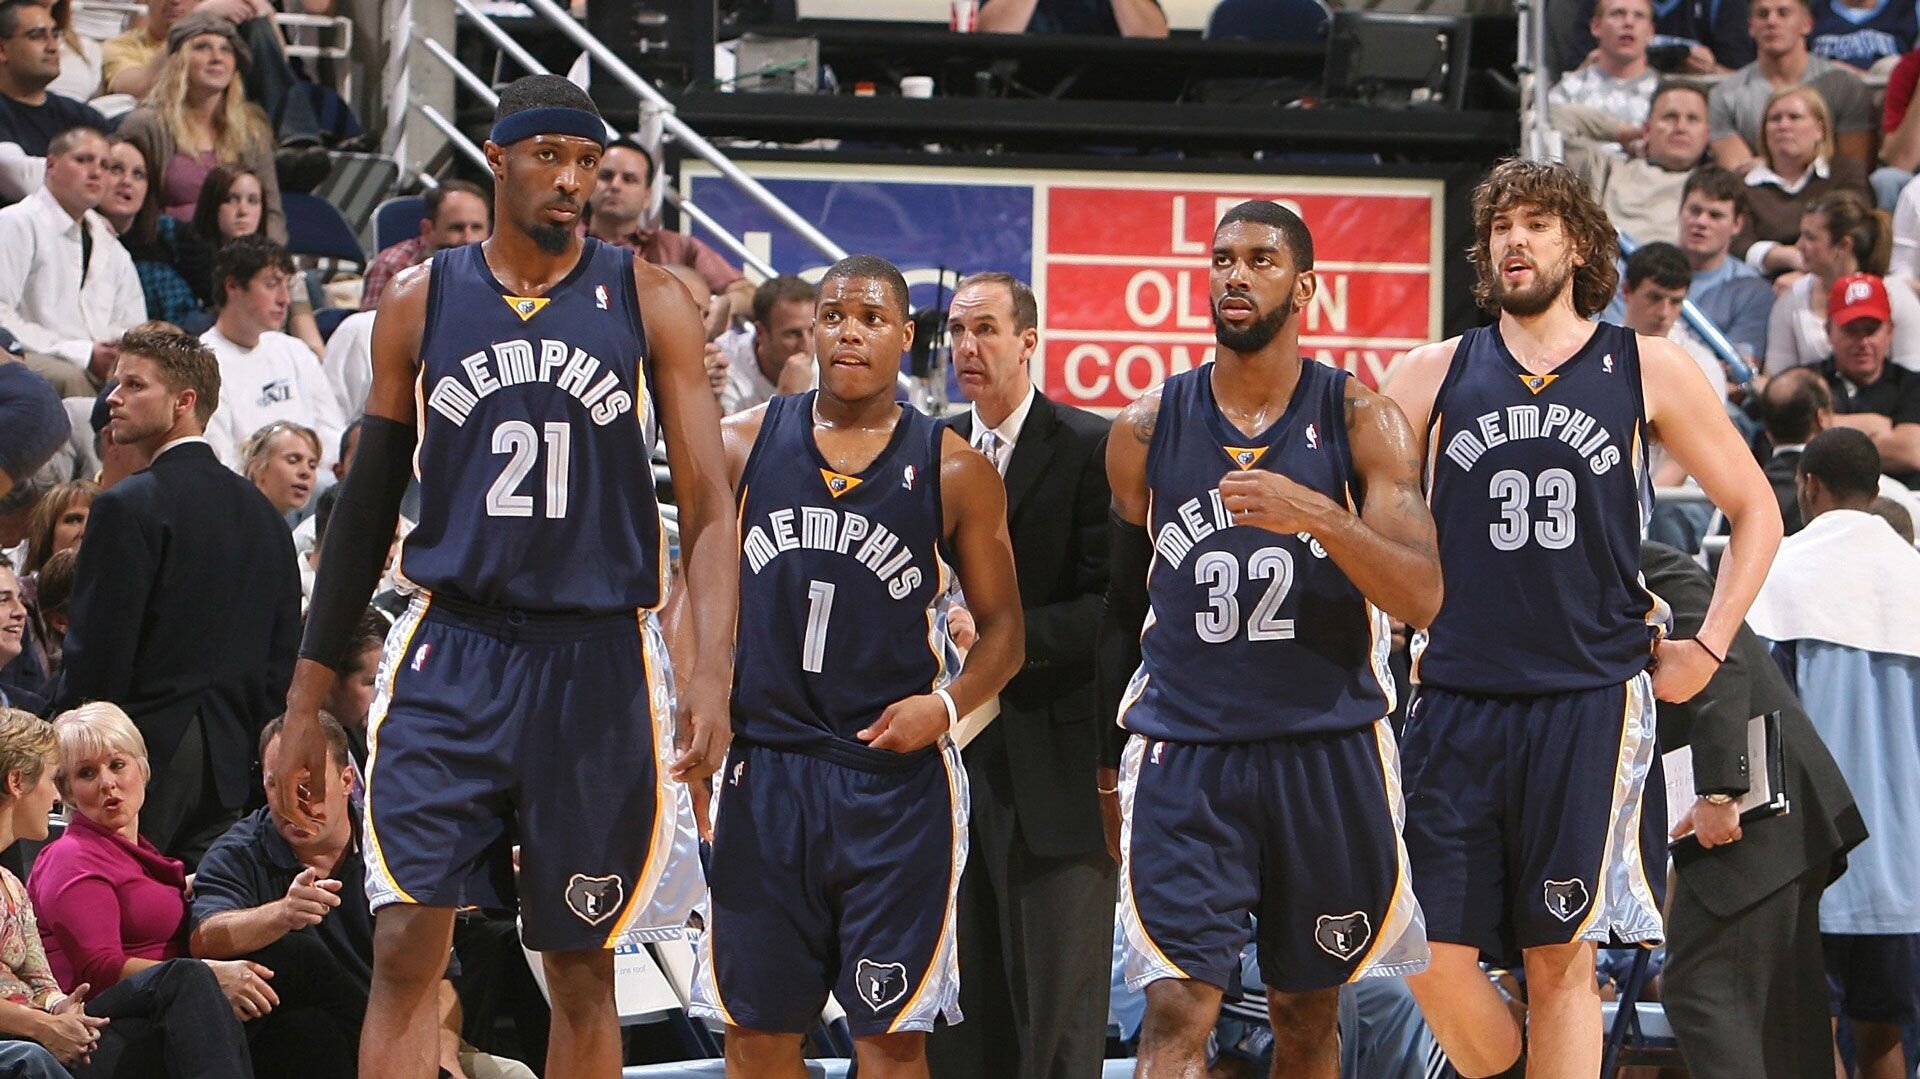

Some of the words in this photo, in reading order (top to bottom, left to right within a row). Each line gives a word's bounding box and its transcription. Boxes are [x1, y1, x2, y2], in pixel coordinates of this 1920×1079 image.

[1124, 269, 1348, 332] OLN
[428, 339, 632, 428] MEMPHIS
[486, 420, 571, 519] 21
[1445, 403, 1621, 476] MEMPHIS
[743, 506, 922, 600] MEMPHIS
[1489, 468, 1577, 551] 33
[802, 580, 836, 674] 1
[1195, 546, 1295, 644] 32
